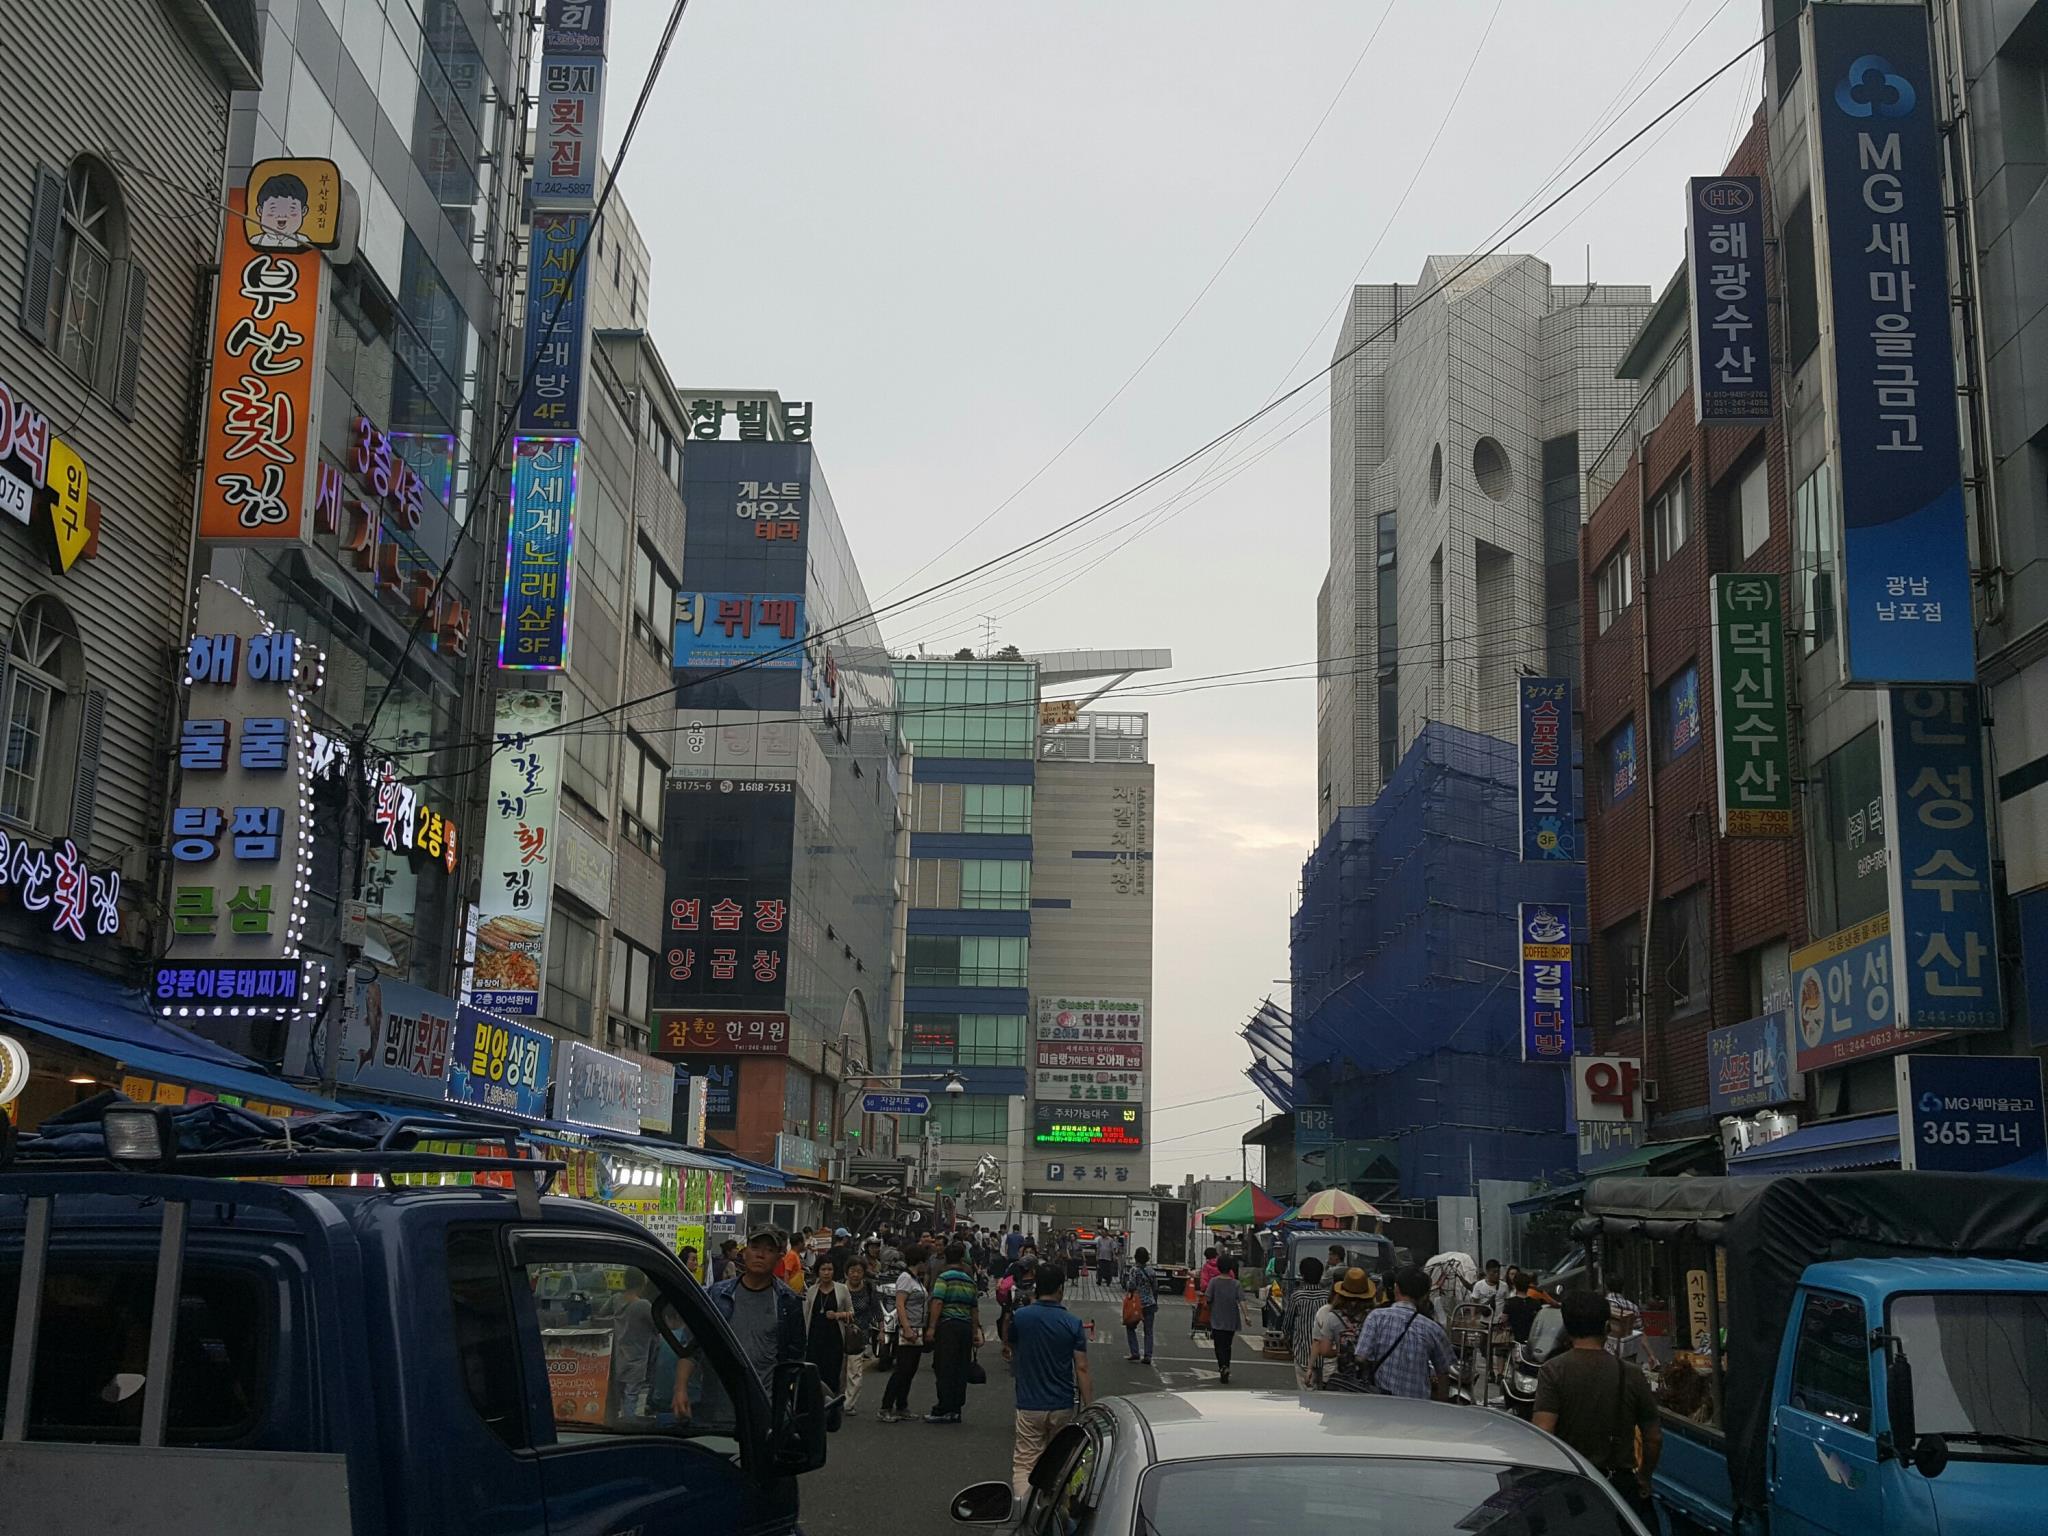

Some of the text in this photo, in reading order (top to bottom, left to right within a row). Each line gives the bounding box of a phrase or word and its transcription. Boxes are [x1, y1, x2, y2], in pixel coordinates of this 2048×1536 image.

[546, 65, 595, 95] 명지
[550, 99, 585, 178] 횟집
[317, 174, 331, 229] 부산횟집
[1710, 189, 1744, 206] HK
[1708, 222, 1757, 383] 해광수산
[1858, 132, 1923, 451] MG새마을금고
[217, 254, 304, 529] 부산횟집
[533, 403, 566, 419] 4F
[61, 465, 83, 542] 입구
[737, 481, 802, 500] 게스트
[736, 501, 801, 520] 하우스
[755, 521, 801, 541] 테라
[1885, 576, 1929, 597] 광남
[714, 599, 797, 639] 뷔페
[1876, 602, 1942, 623] 남포점
[518, 638, 550, 653] 3F
[688, 720, 705, 753] 요양
[1538, 834, 1556, 846] 3F
[670, 898, 787, 932] 연습장
[667, 949, 781, 982] 양곱창
[1524, 946, 1570, 959] COFFEE SHOP
[156, 969, 297, 999] 양푼이동태찌개
[726, 1020, 785, 1042] 한의원
[1917, 1010, 1996, 1025] 244-0613
[384, 1010, 450, 1080] 명지횟집
[471, 1021, 541, 1088] 밀양상회
[1585, 1061, 1640, 1119] 약
[1055, 1108, 1110, 1119] 주차가능대수
[1944, 1097, 2036, 1112] MG새마을금고
[1923, 1120, 2021, 1148] 365 코너
[1072, 1165, 1129, 1182] 주차장
